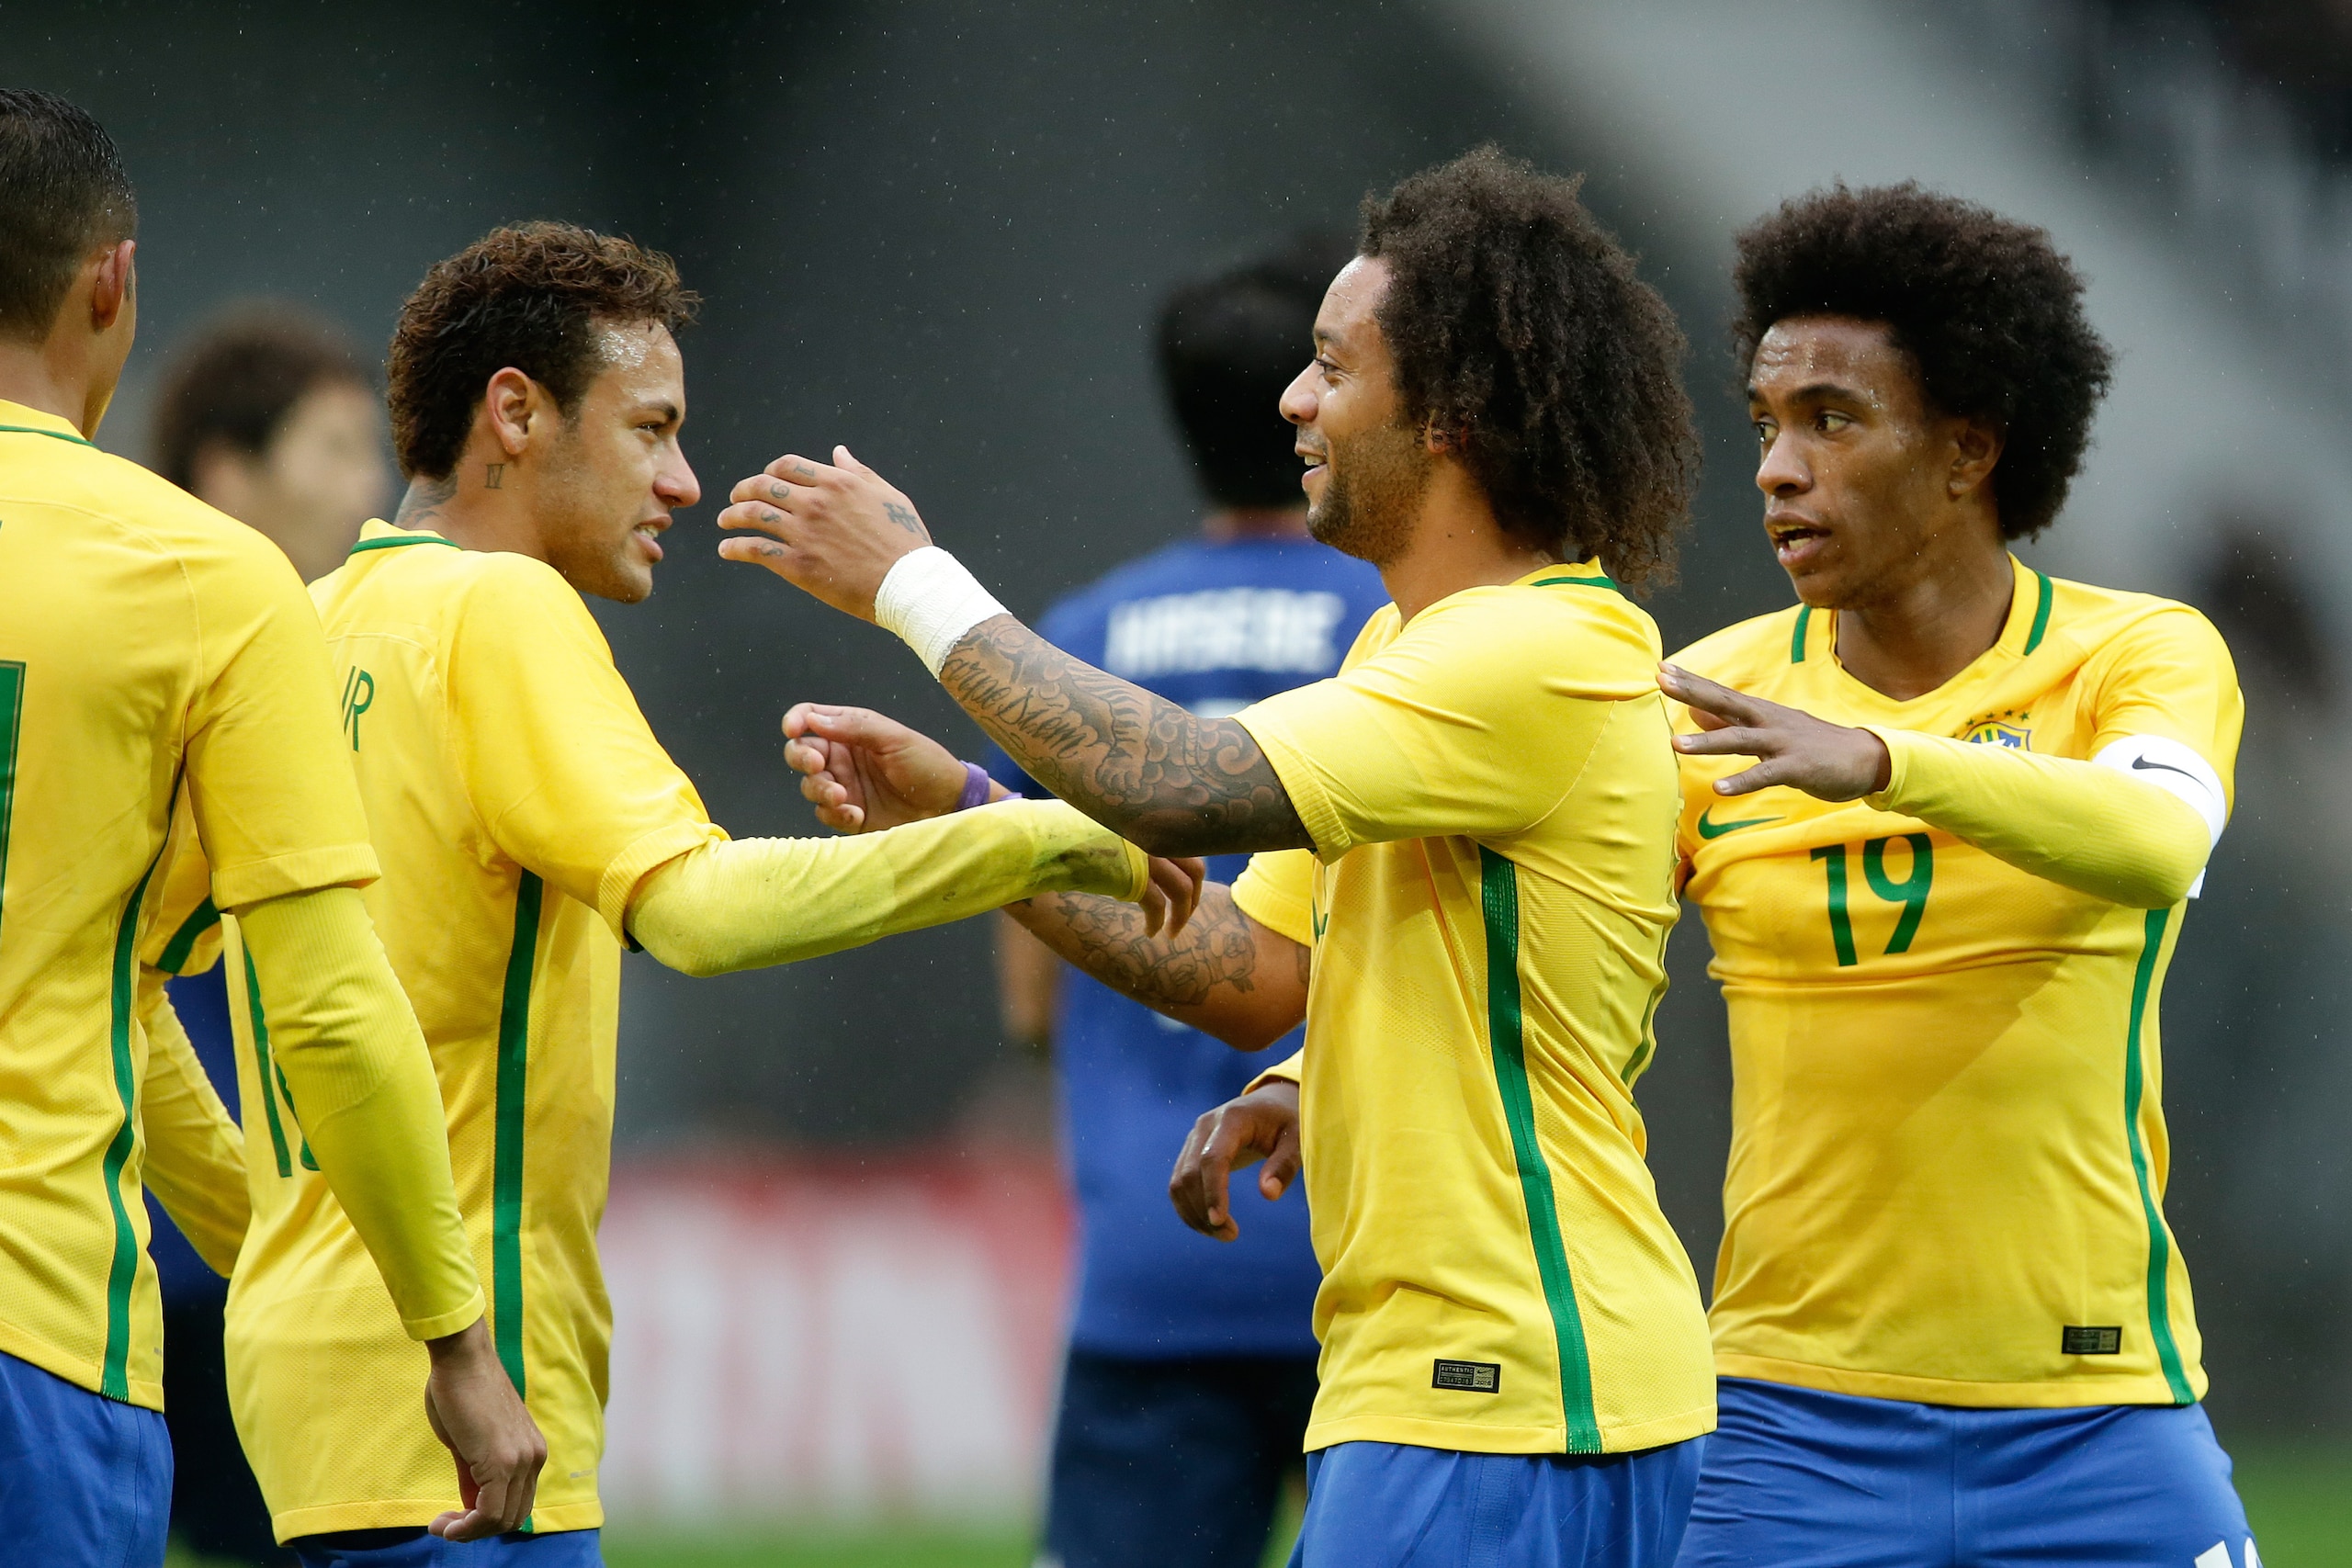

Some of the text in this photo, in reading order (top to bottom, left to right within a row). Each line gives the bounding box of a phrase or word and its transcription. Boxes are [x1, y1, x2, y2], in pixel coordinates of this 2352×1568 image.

[939, 648, 1012, 710] arpe
[1810, 831, 1935, 967] 19
[1441, 1366, 1474, 1374] AUTHENTIC
